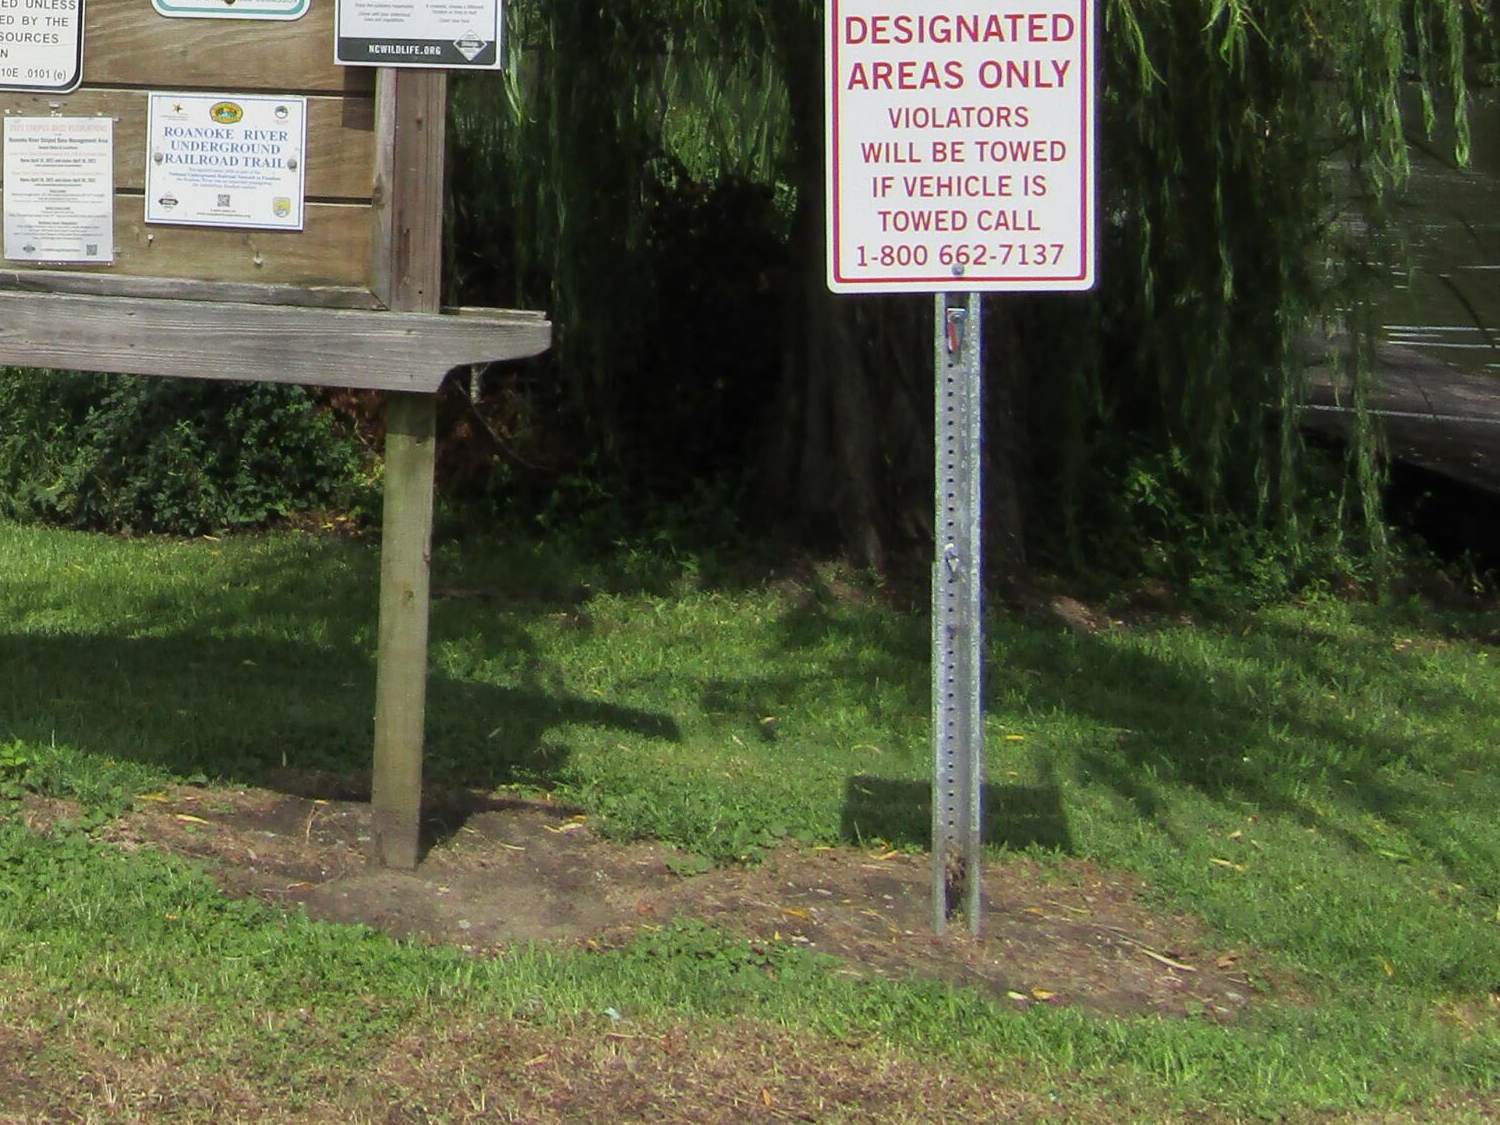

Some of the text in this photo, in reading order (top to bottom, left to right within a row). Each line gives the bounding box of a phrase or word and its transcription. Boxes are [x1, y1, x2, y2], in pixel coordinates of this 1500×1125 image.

[845, 14, 1074, 44] DESIGNATED
[369, 45, 441, 55] NCWILDLIFE.ORG
[848, 60, 1071, 90] AREAS ONLY
[888, 107, 1029, 128] VIOLATORS
[164, 127, 288, 141] ROANOKE RIVER
[171, 140, 280, 154] UNDERGROUND
[861, 141, 1066, 163] WILL BE TOWED
[165, 154, 285, 168] RAILROAD TRAIL
[872, 175, 1047, 198] IF VEHICLE IS
[878, 210, 1041, 232] TOWED CALL
[858, 244, 1064, 266] 1-800 662-7137
